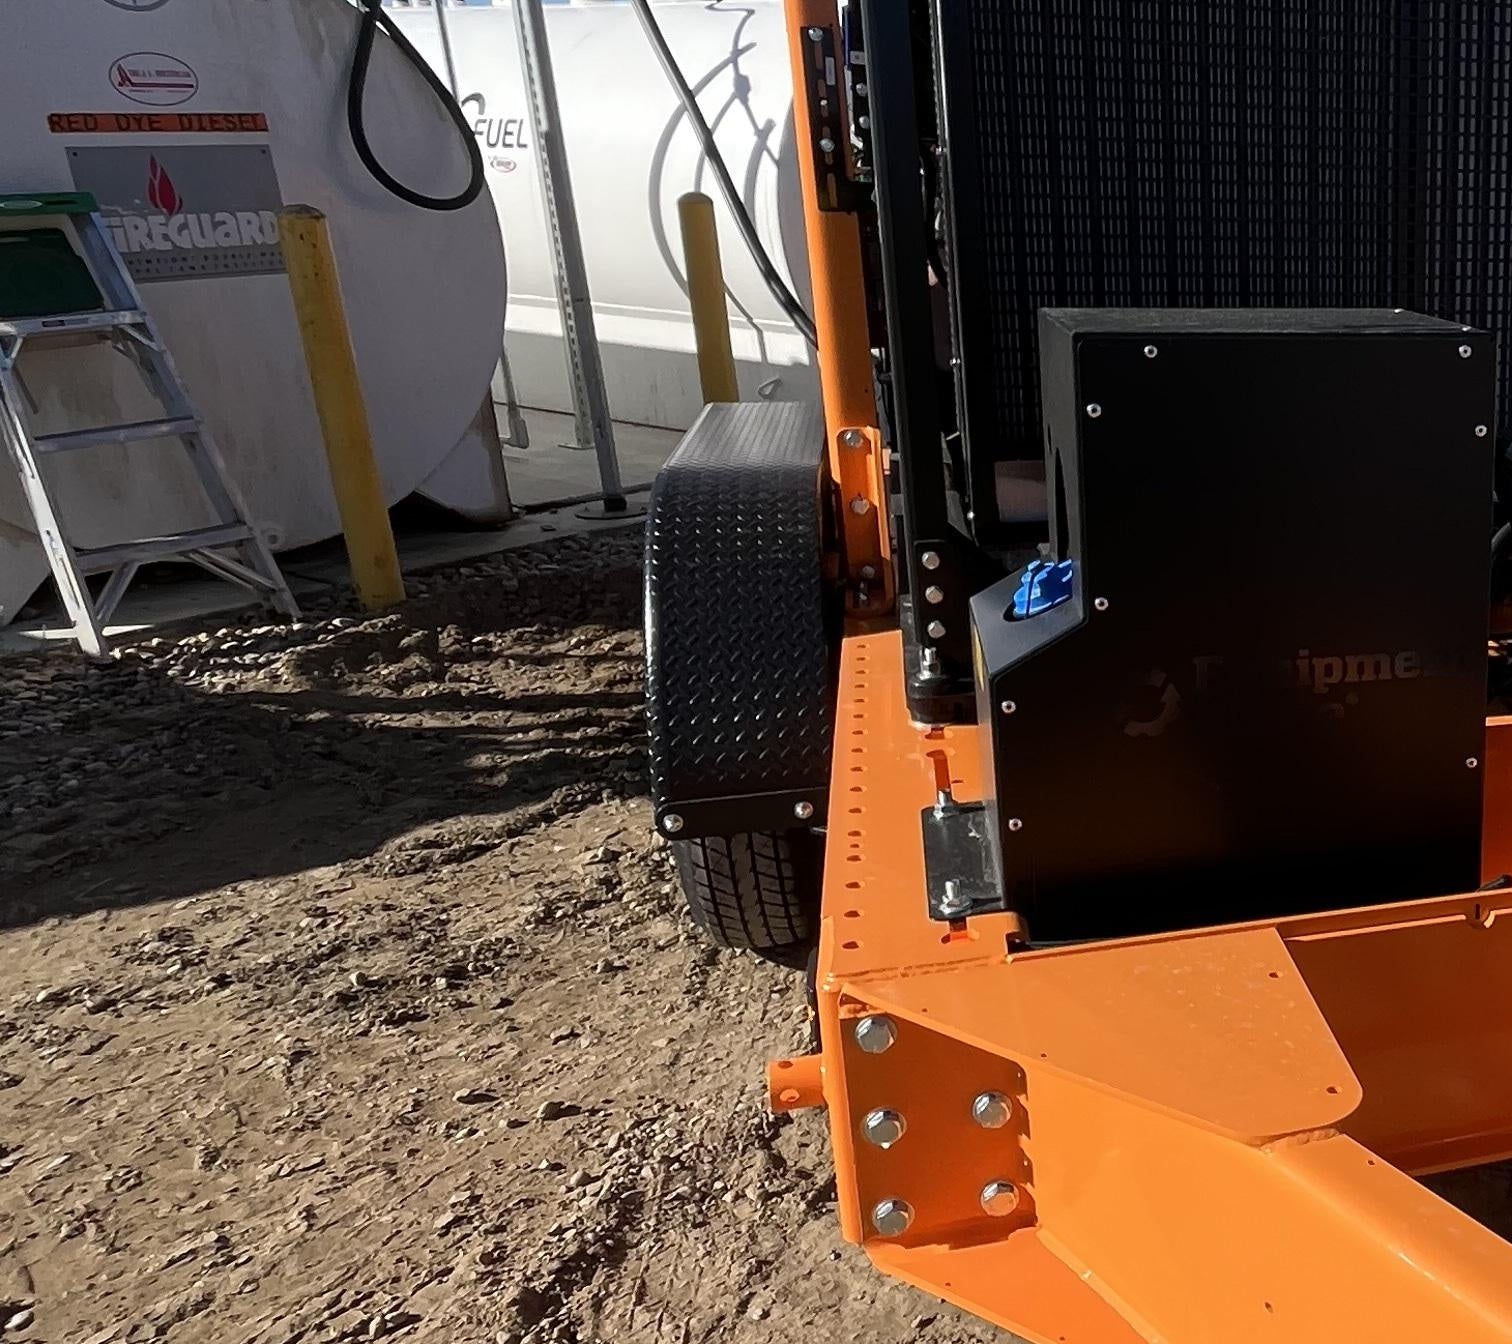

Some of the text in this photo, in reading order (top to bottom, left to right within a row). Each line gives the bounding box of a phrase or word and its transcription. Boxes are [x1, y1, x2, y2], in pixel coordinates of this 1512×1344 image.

[49, 113, 267, 133] RED DYE DIESEL
[474, 118, 528, 149] FUEL
